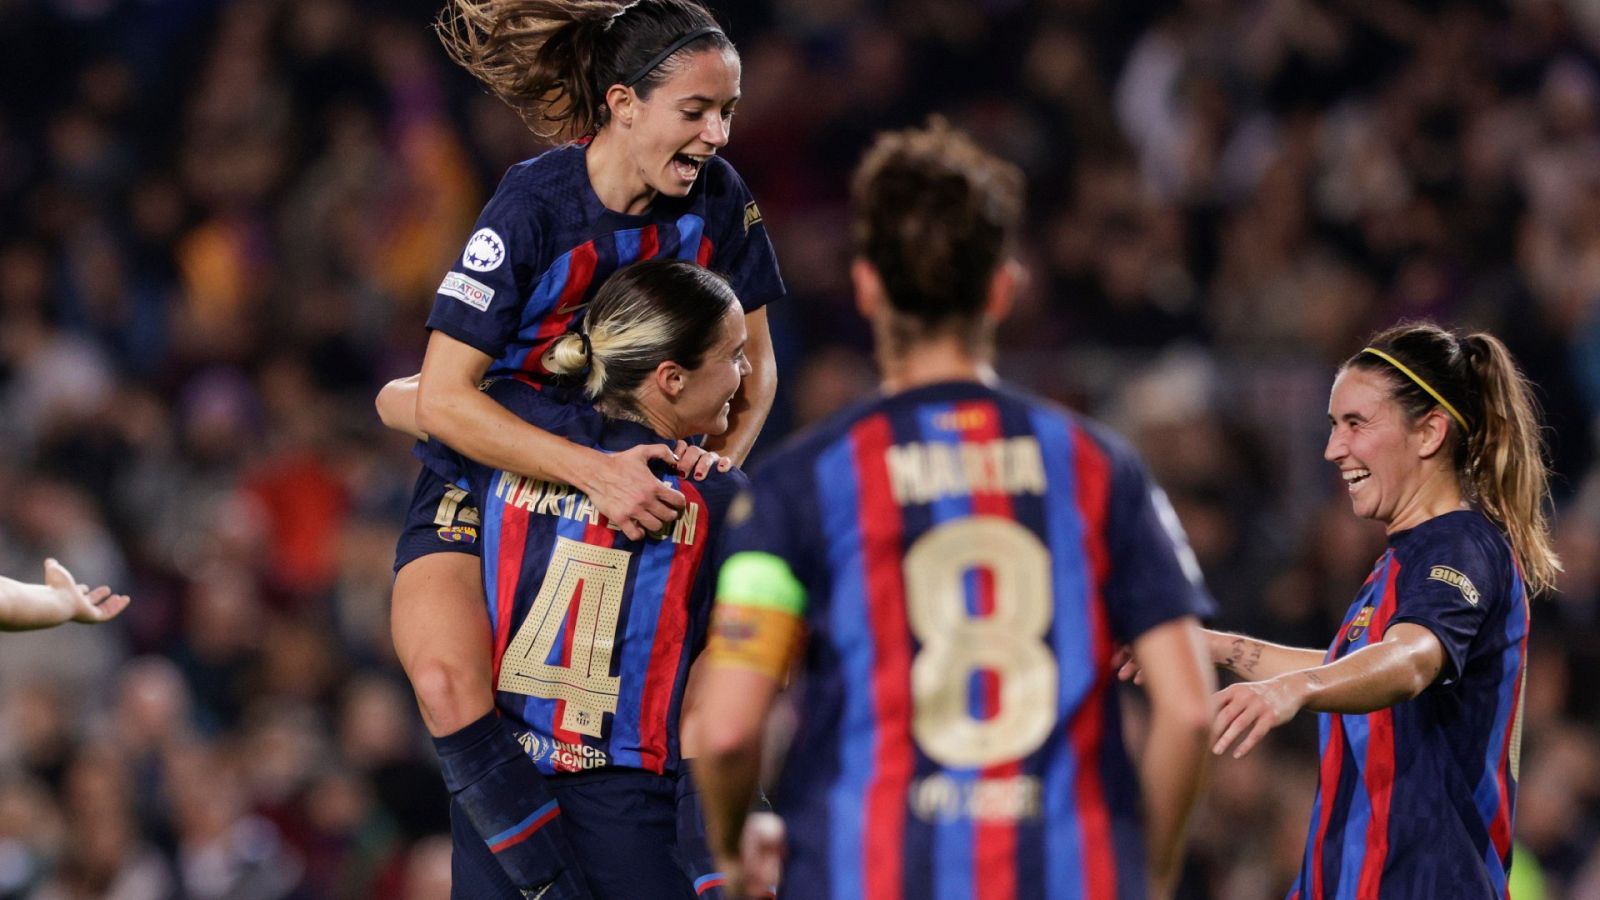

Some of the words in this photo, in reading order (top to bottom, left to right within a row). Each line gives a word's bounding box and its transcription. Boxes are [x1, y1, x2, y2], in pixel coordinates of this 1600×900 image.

[497, 535, 632, 738] 4
[903, 515, 1059, 768] 8
[1430, 567, 1479, 604] BIMBO
[552, 738, 607, 758] UNHCR
